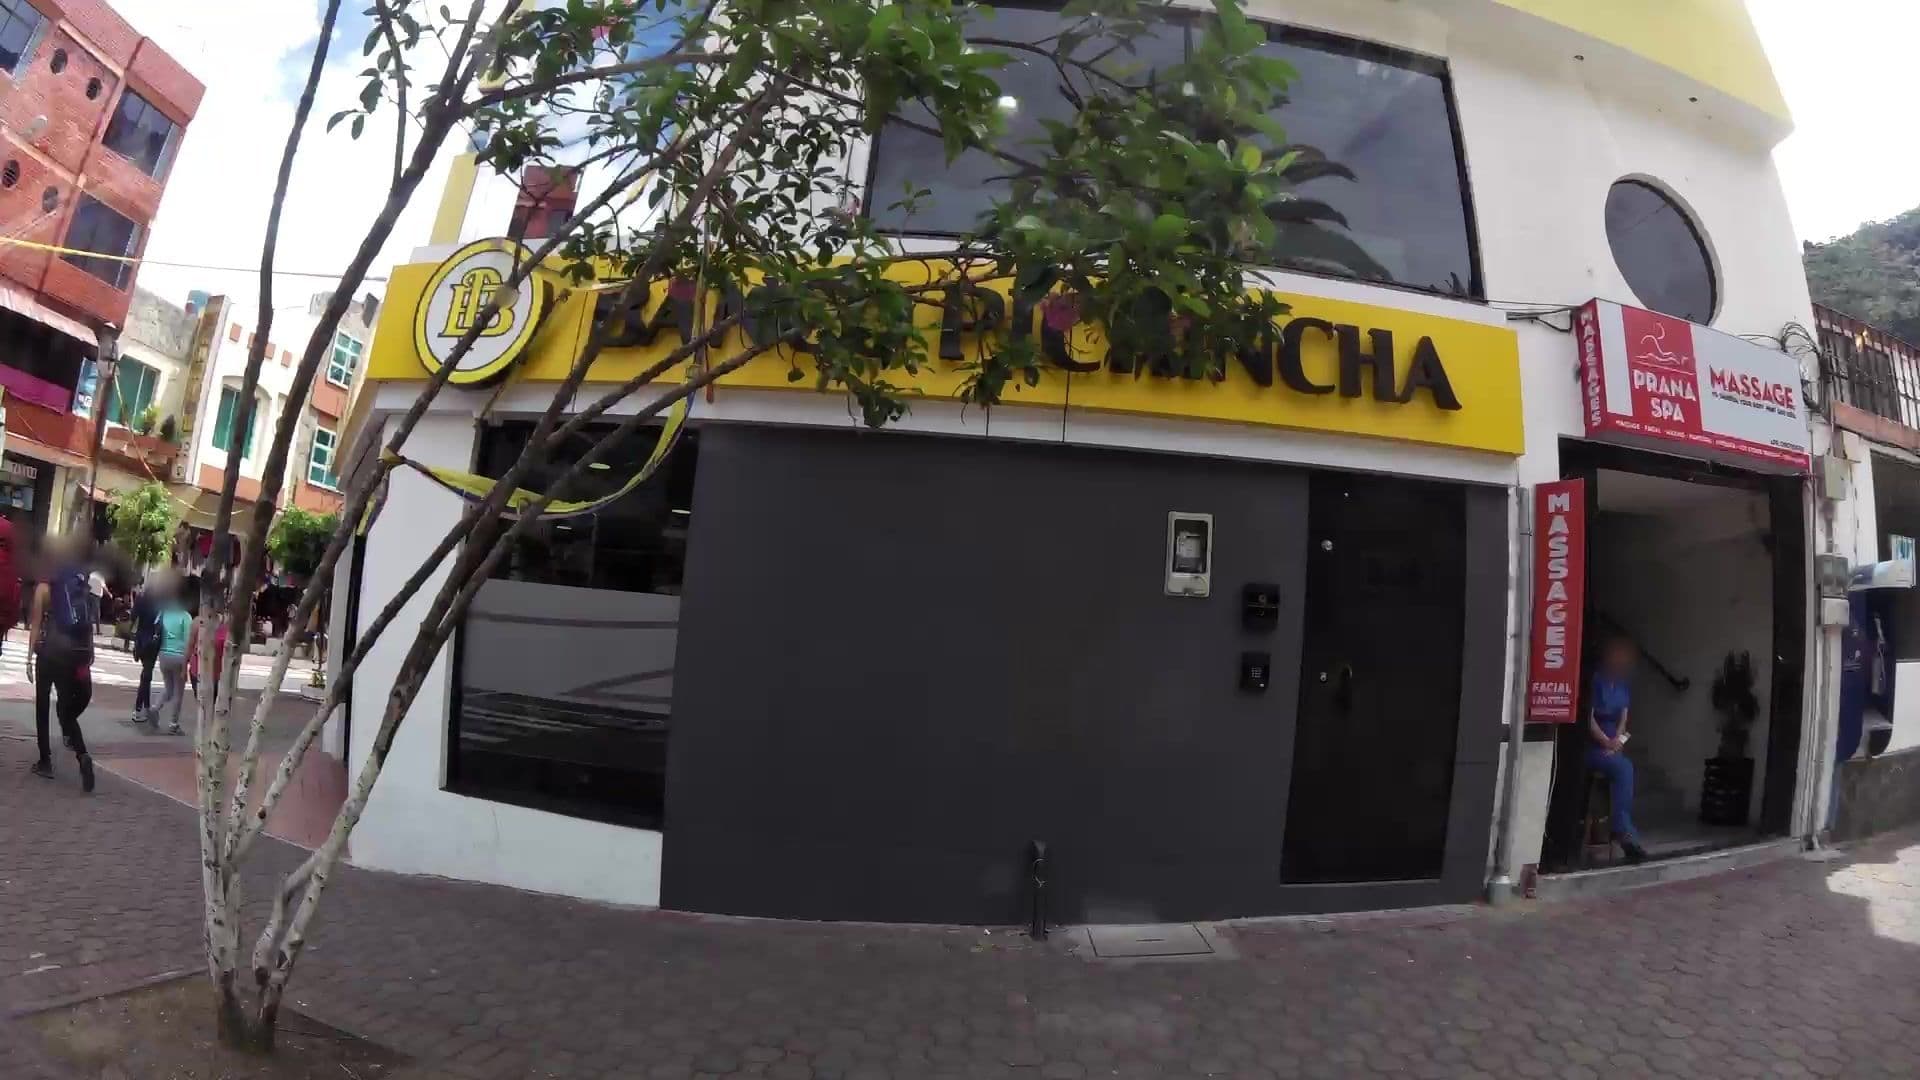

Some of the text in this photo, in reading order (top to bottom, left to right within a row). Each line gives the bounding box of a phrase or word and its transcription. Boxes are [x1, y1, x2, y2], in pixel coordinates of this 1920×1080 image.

[1632, 369, 1697, 402] PRANA
[1709, 366, 1796, 409] MASSAGE
[1651, 398, 1685, 423] SPA
[1544, 491, 1570, 669] MASSAGES
